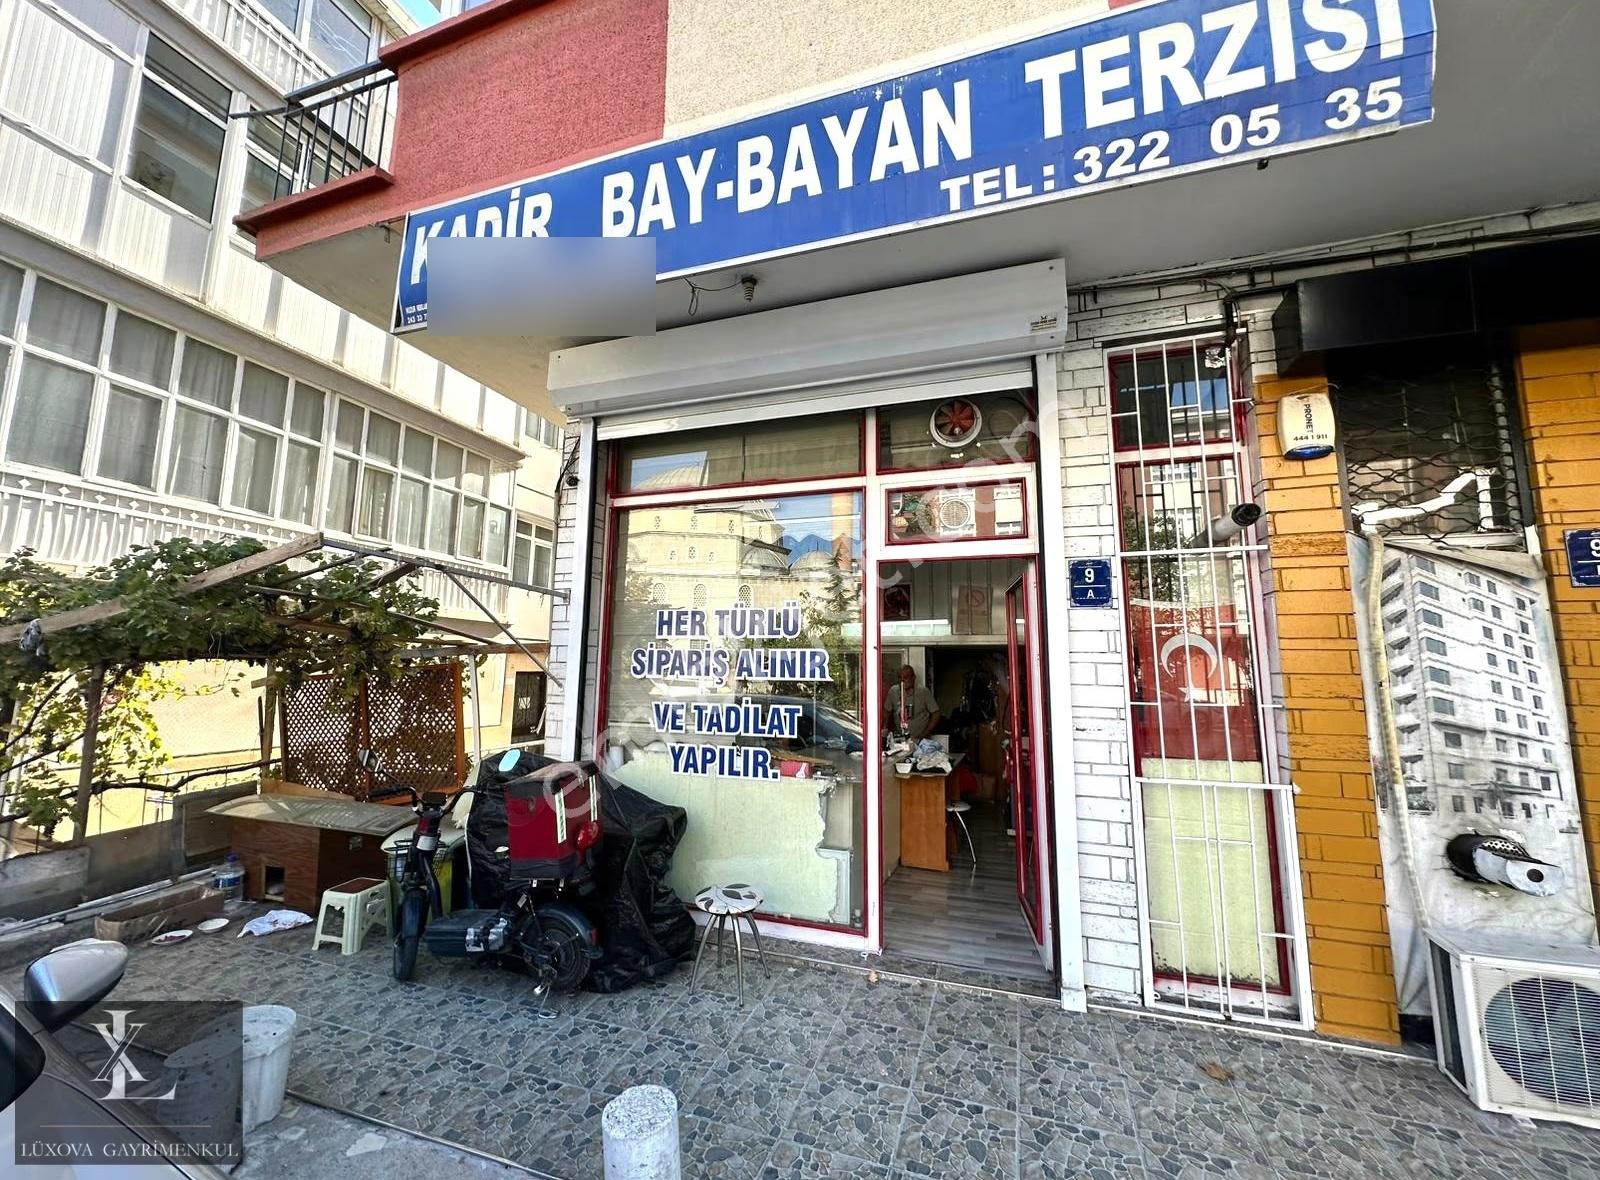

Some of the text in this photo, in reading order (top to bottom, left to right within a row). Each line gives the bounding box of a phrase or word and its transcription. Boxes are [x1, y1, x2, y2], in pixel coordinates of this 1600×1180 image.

[602, 79, 972, 238] BAY-BAYAN
[940, 76, 1403, 211] TEL: 322 05 35
[1304, 403, 1313, 433] PRONET
[1084, 568, 1095, 583] 9
[1087, 589, 1095, 599] A
[656, 601, 801, 639] HER TÜRLÜ
[631, 642, 829, 686] SİPARİŞ ALINIR
[653, 698, 801, 737] VE TADİLAT
[669, 744, 780, 780] YAPILIR.
